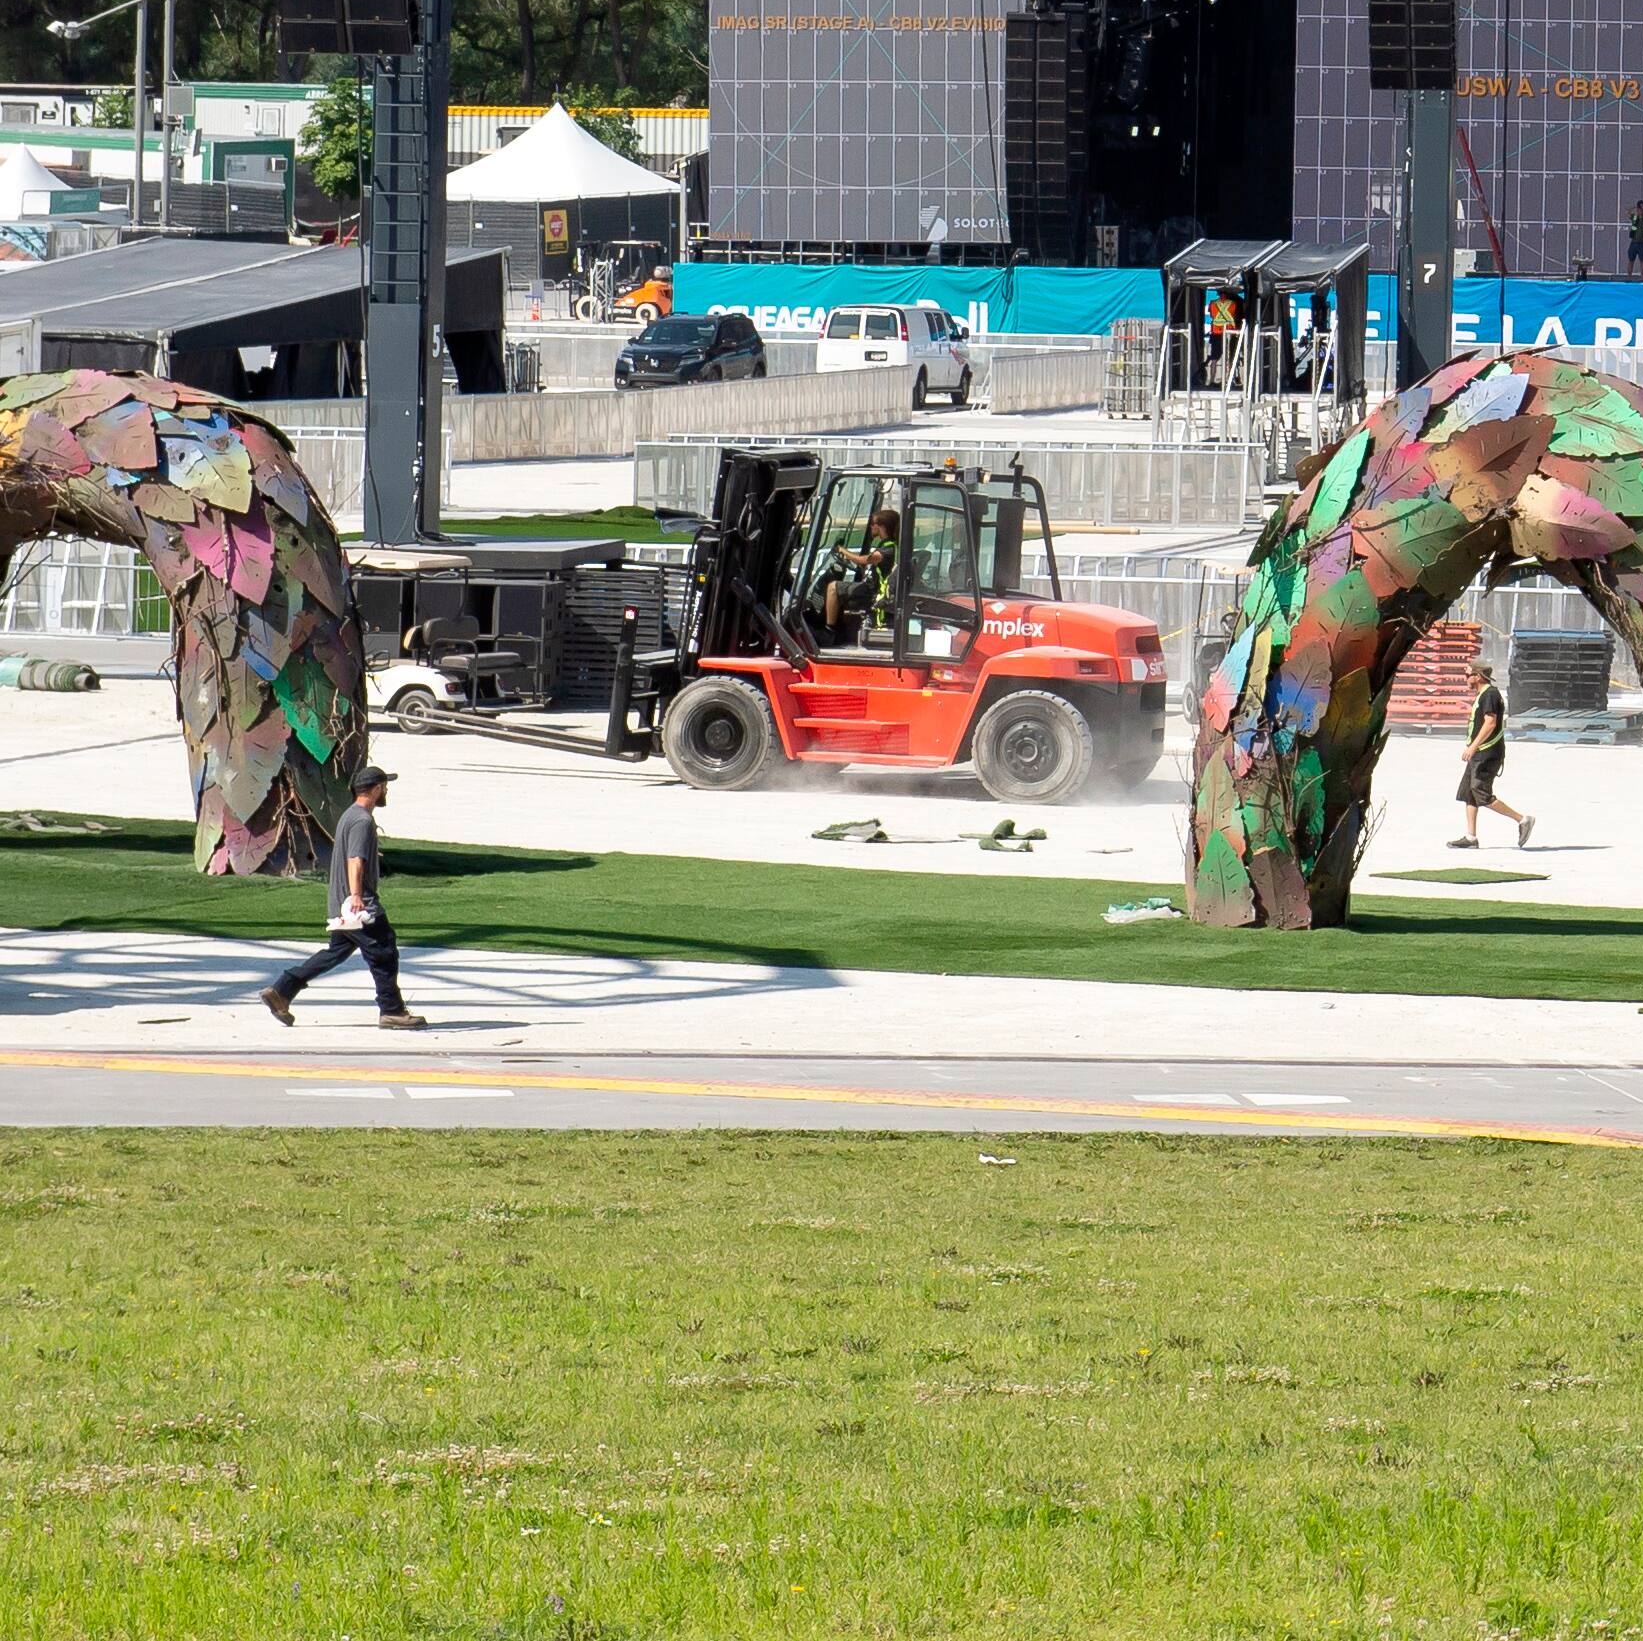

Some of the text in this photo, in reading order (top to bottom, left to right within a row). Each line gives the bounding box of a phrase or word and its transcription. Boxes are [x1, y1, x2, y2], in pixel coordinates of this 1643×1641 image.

[1456, 77, 1508, 98] USW
[1517, 78, 1535, 97] A
[1555, 78, 1604, 99] CB8
[1610, 79, 1640, 100] V3
[1423, 264, 1437, 284] 7
[432, 324, 440, 358] 5
[983, 617, 1045, 640] mplex
